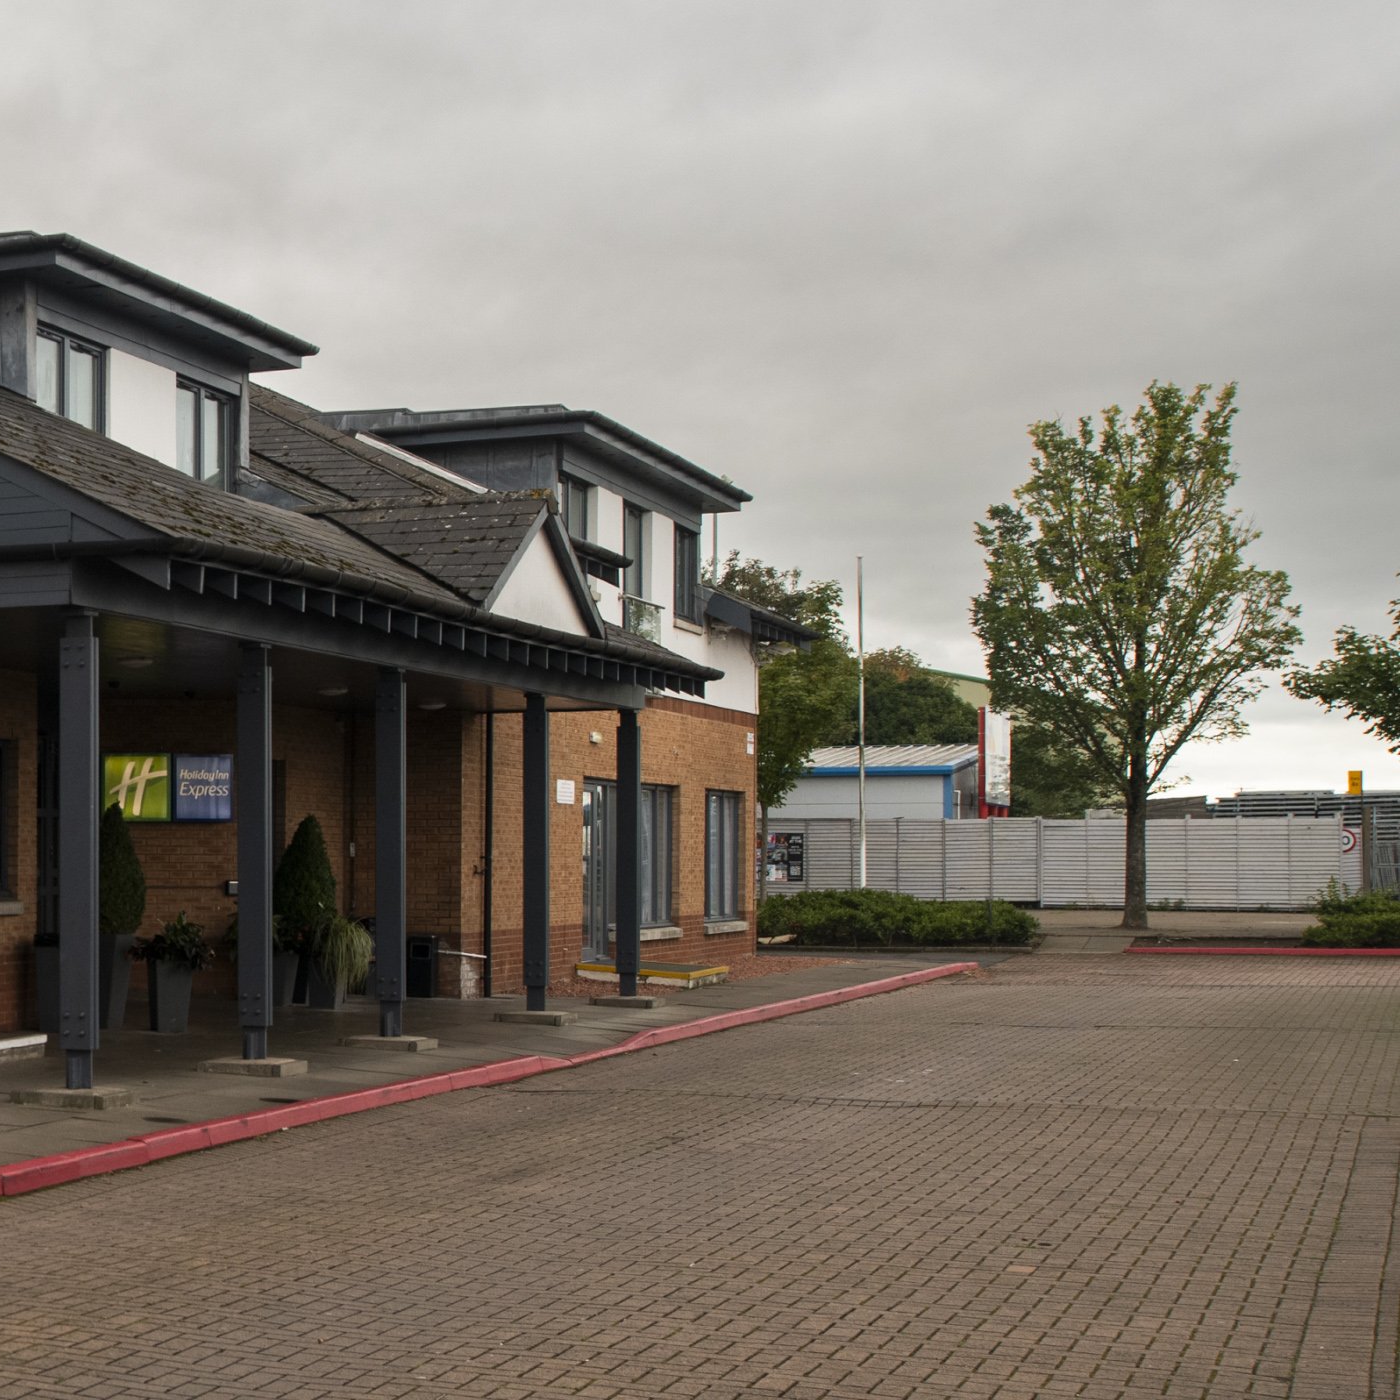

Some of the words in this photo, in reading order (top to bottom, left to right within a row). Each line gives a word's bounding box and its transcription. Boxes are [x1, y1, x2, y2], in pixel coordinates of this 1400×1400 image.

[179, 769, 215, 781] Holiday
[214, 770, 230, 781] Inn
[179, 782, 230, 799] Express
